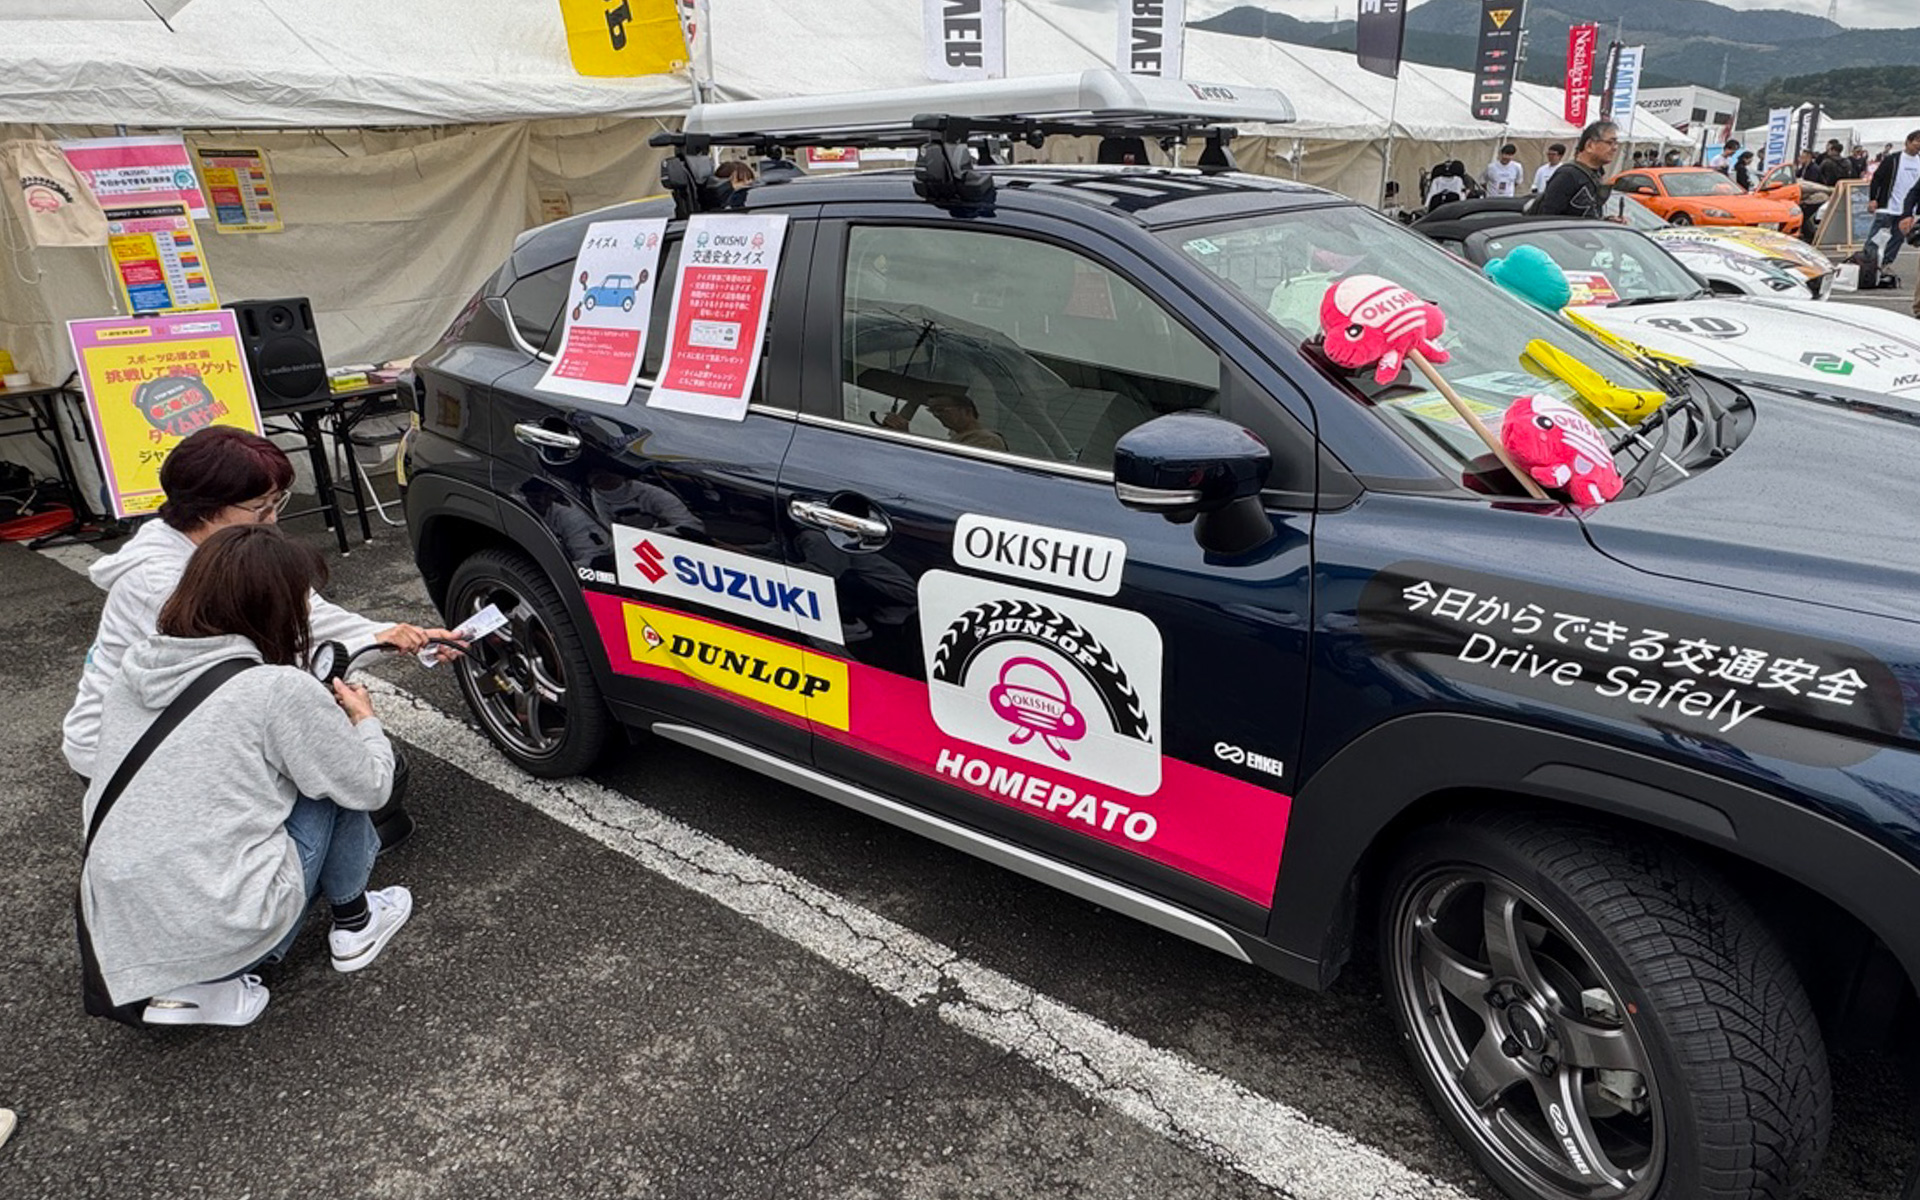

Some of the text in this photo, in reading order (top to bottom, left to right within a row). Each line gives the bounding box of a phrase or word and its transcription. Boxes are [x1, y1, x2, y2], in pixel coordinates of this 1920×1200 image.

[1569, 29, 1591, 118] Nostalgic Hero
[691, 250, 765, 265] 交通安全クイズ
[713, 235, 748, 247] OKISHU
[127, 350, 211, 366] スポーツ応援企画
[965, 526, 1112, 583] OKISHU
[672, 555, 821, 621] SUZUKI
[669, 634, 831, 698] DUNLOP
[988, 617, 1098, 668] DUNLOP
[1402, 580, 1867, 706] 今日からできる交通安全
[1012, 693, 1061, 717] OKISHU
[1457, 632, 1765, 733] Drive Safely
[1247, 751, 1283, 777] ENKEI
[935, 749, 1157, 842] HOMEPATO
[1562, 1137, 1592, 1175] ENKEI
